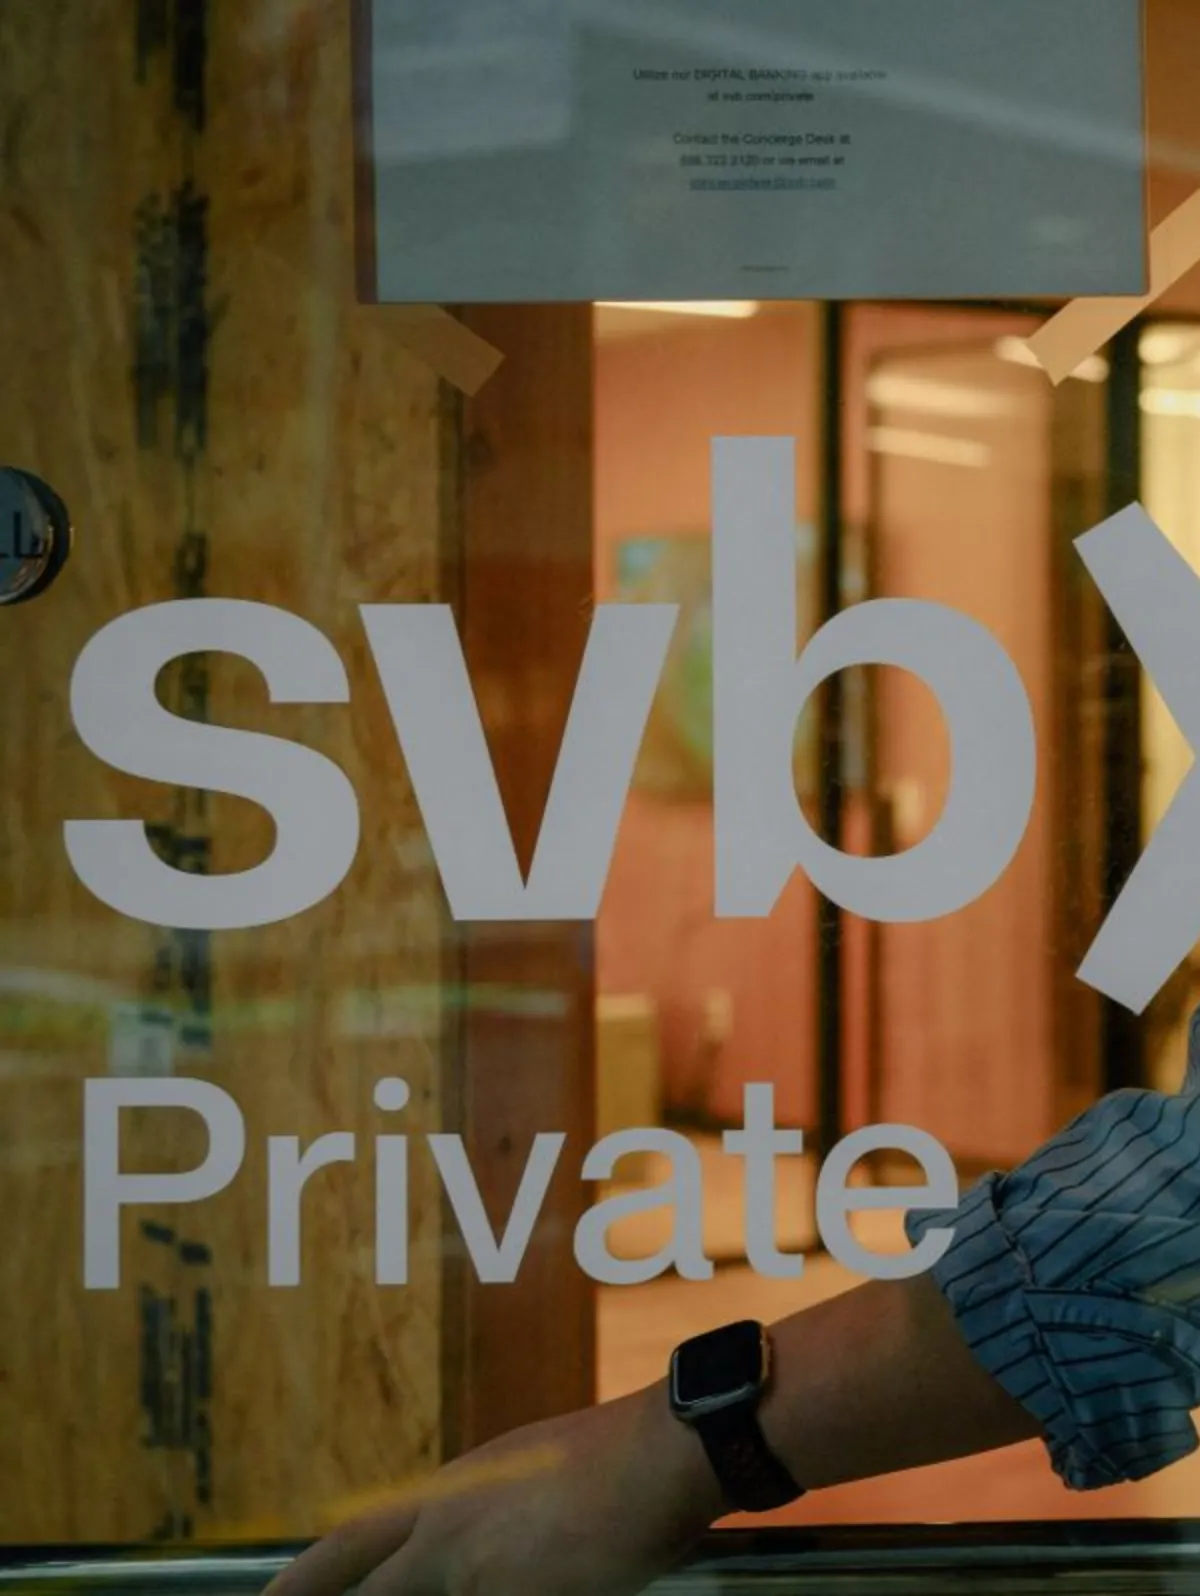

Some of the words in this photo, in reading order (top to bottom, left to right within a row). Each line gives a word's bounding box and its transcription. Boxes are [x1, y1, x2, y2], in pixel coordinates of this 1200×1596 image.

[693, 68, 746, 81] DIGITAL
[672, 132, 718, 145] Contact
[721, 132, 739, 145] the
[742, 132, 803, 147] Concierge
[805, 132, 835, 145] Desk
[839, 133, 851, 145] at
[63, 436, 1036, 929] svb
[82, 1077, 959, 1289] Private
